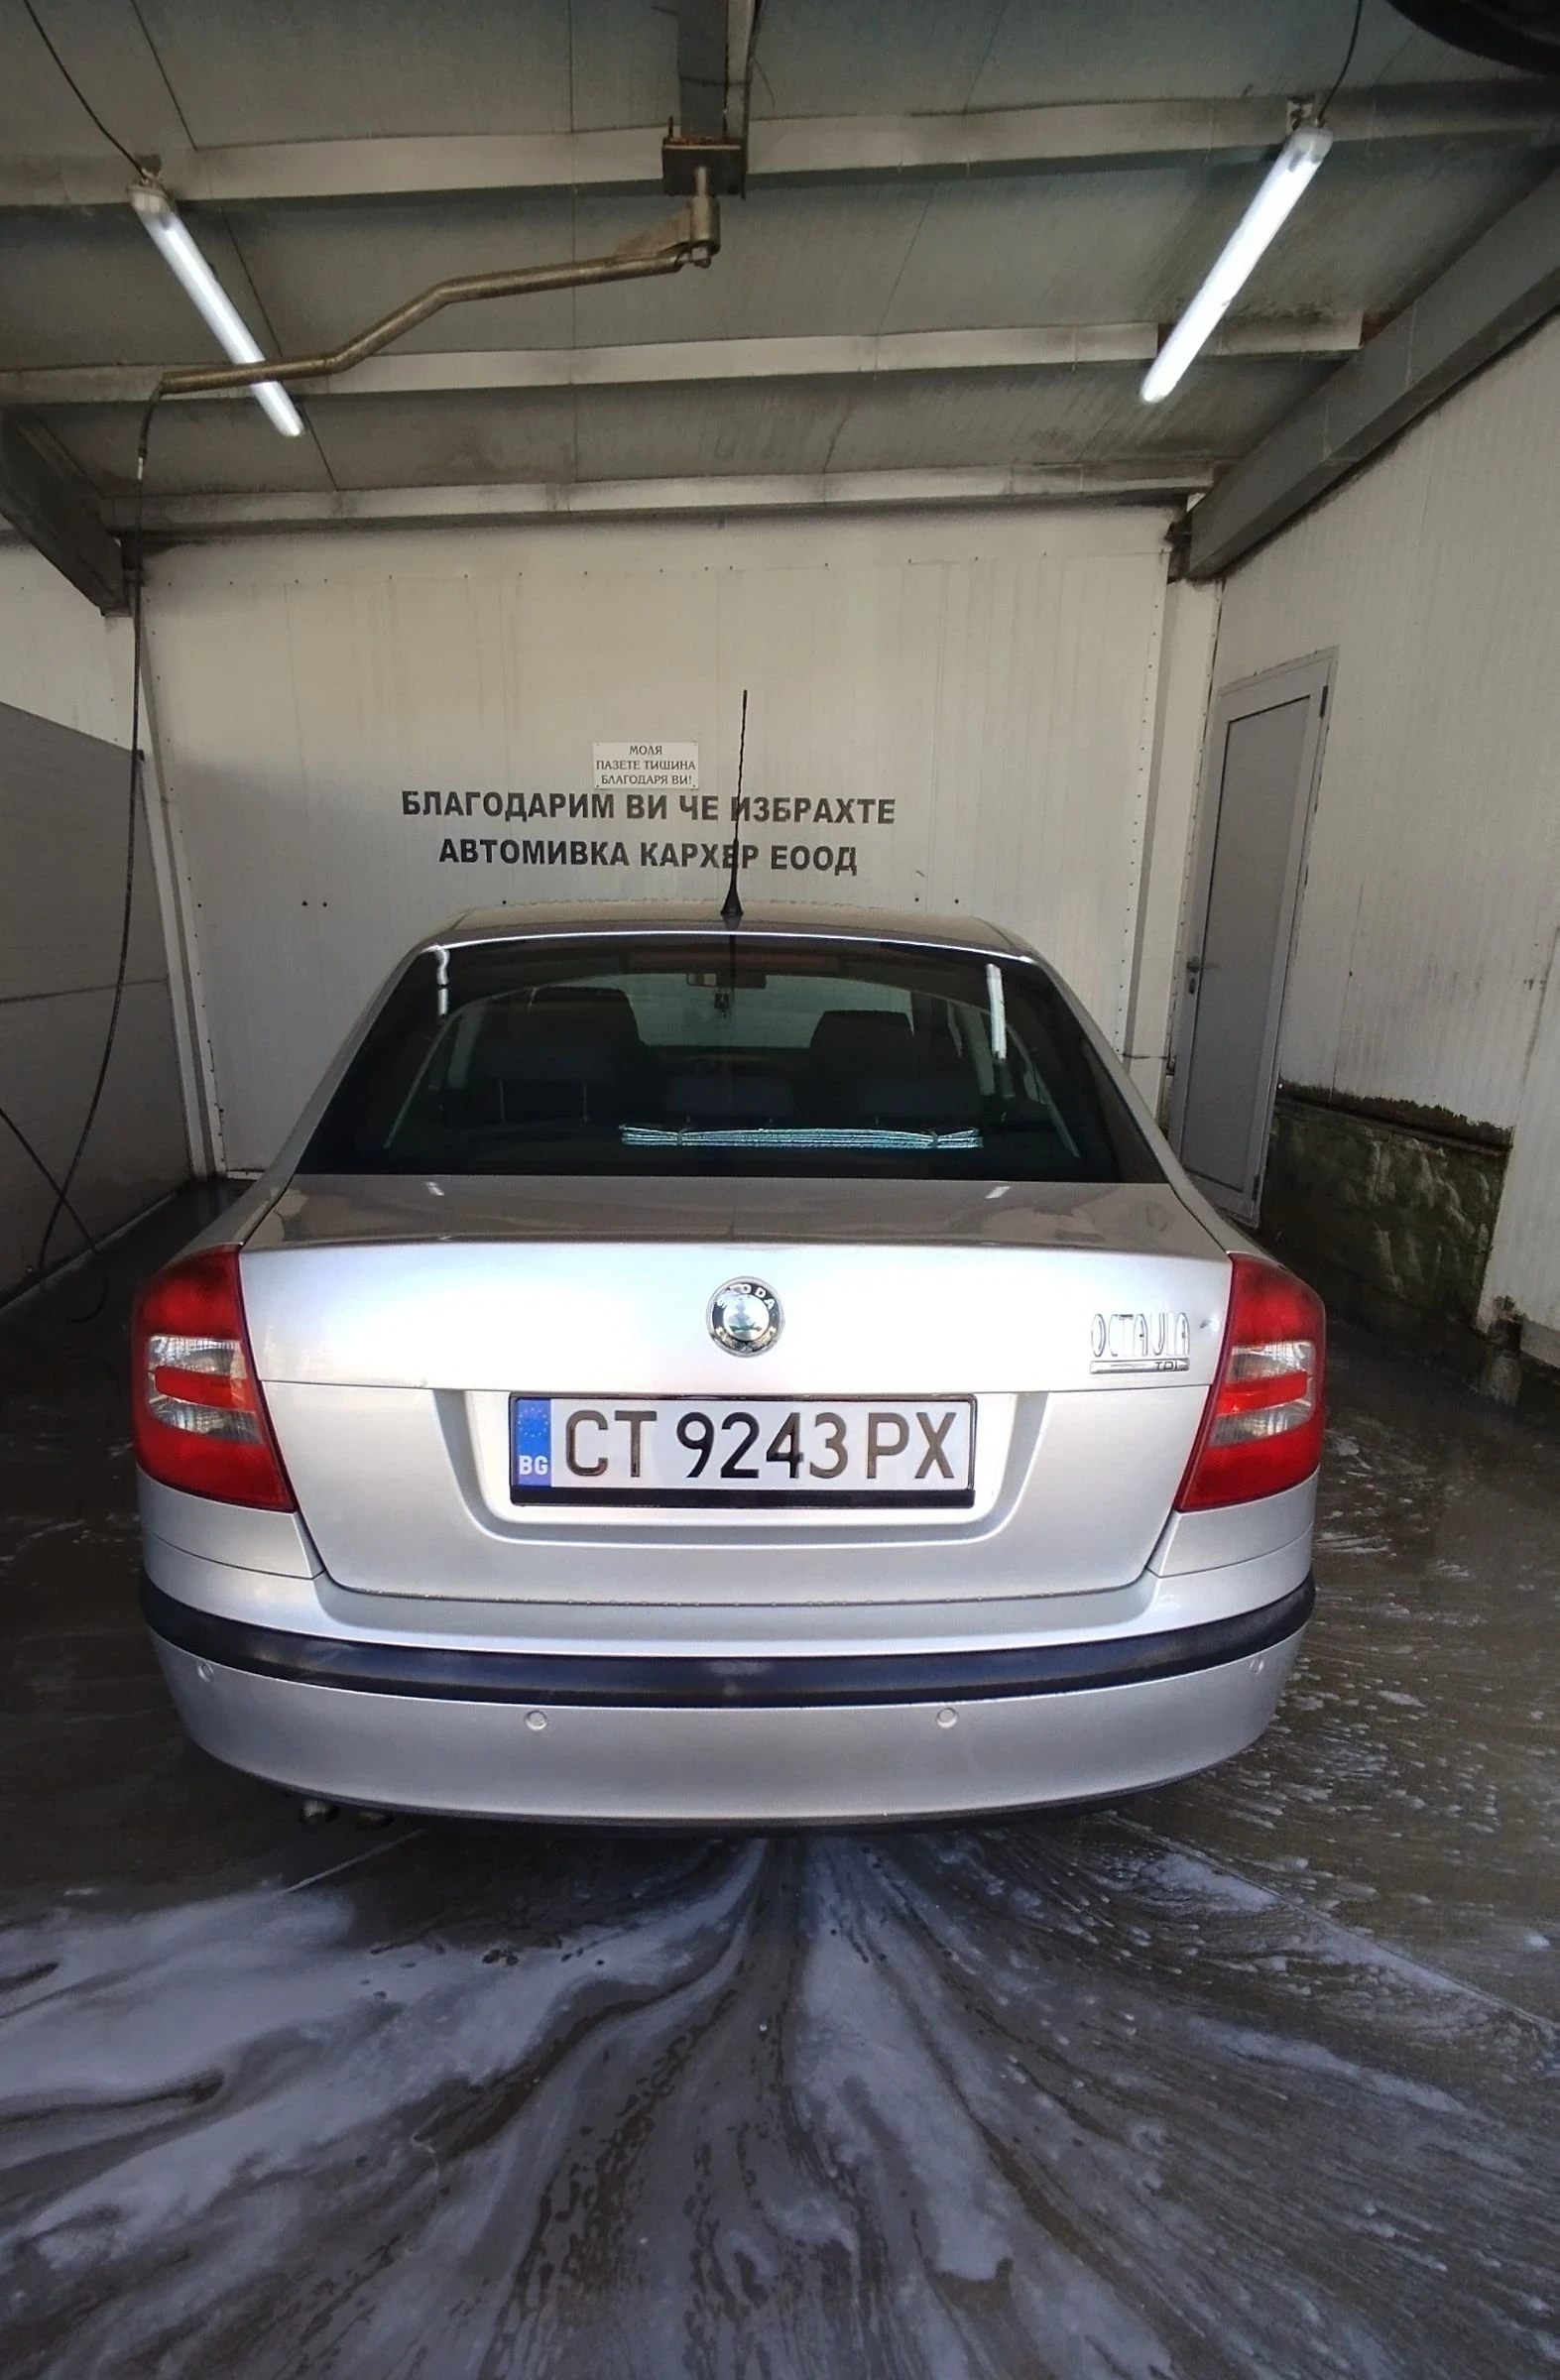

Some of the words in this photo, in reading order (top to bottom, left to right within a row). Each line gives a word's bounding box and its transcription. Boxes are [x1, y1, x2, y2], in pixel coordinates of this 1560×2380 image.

[629, 745, 662, 756] МОЛЯ
[596, 760, 641, 771] ПАЗЕТЕ
[644, 760, 696, 771] ТИШИНА
[601, 774, 668, 785] БЛАГОДАРЯ
[671, 774, 692, 785] ВИ!
[402, 790, 615, 822] БЛАГОДАРИМ
[626, 794, 667, 819] ВИ
[679, 795, 719, 821] ЧЕ
[730, 795, 897, 825] ИЗБРАХТЕ
[438, 838, 631, 867] АВТОМИВКА
[641, 842, 760, 870] КАРХЕР
[771, 845, 858, 877] ЕООД
[519, 1455, 548, 1476] BG
